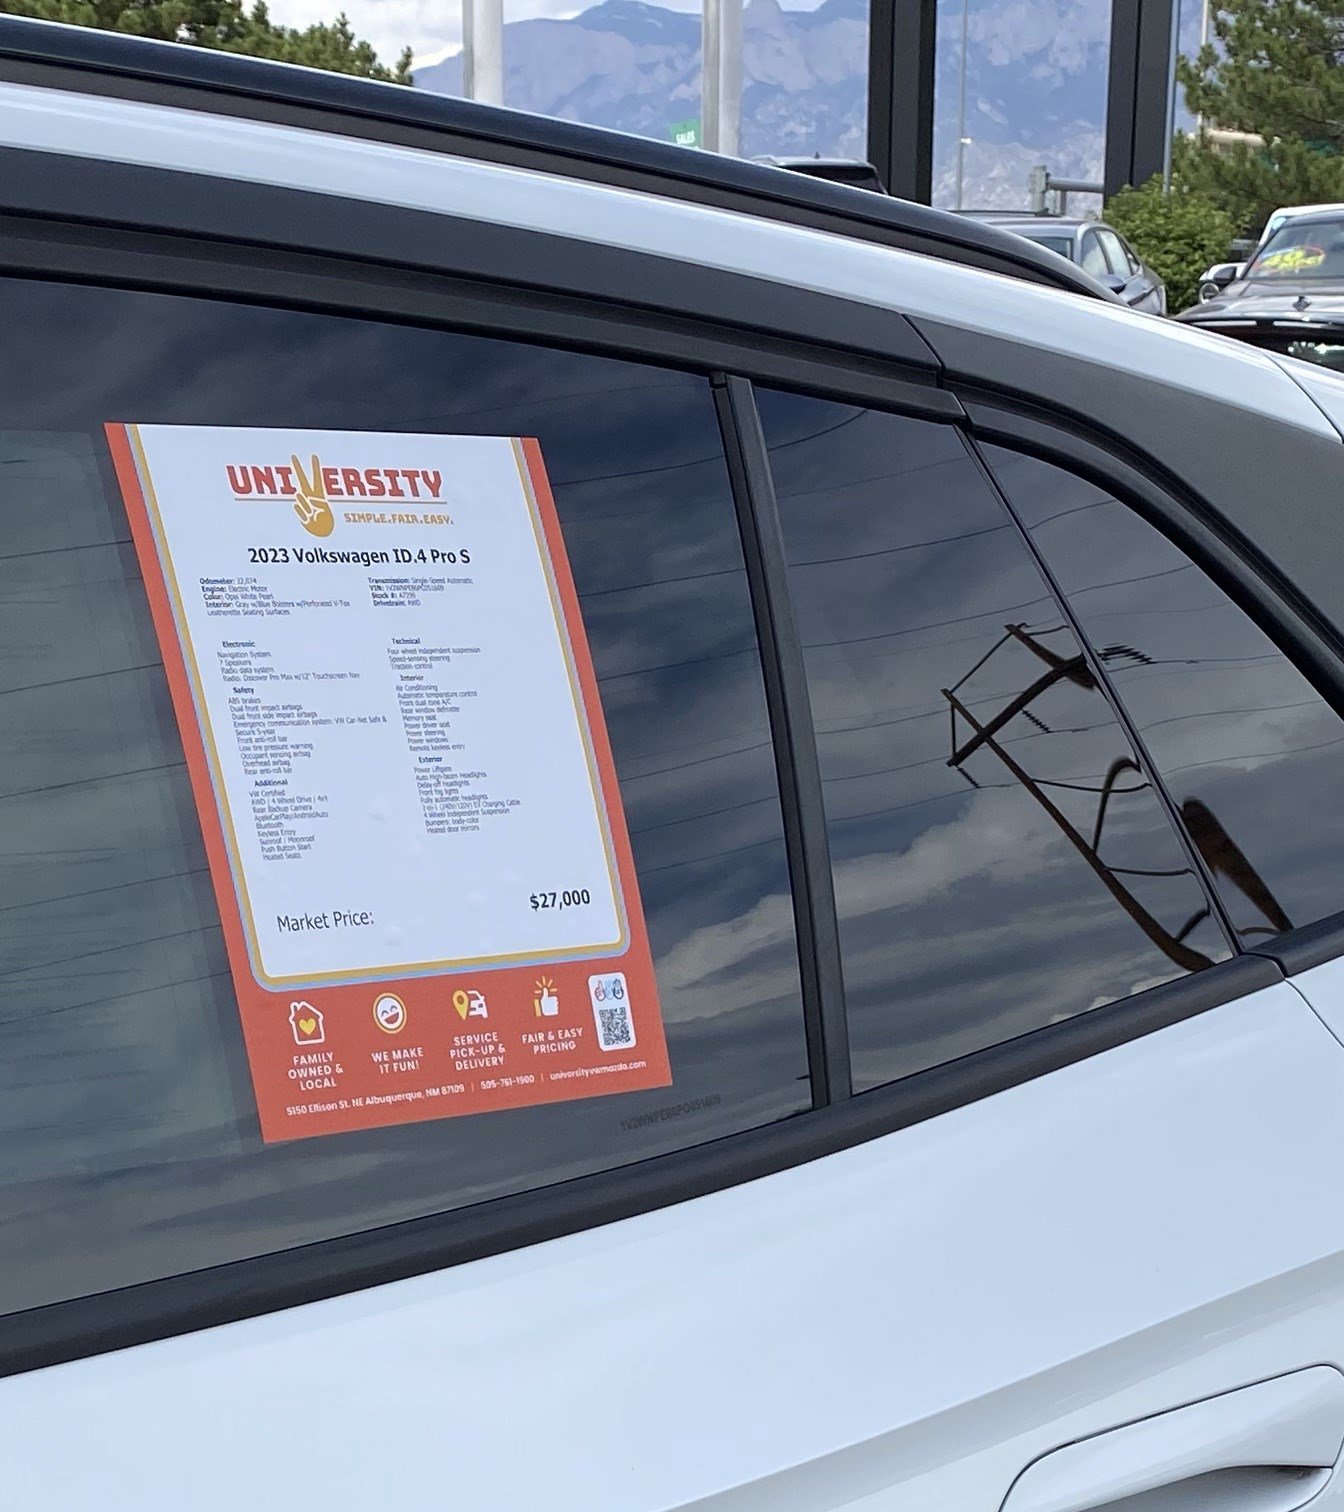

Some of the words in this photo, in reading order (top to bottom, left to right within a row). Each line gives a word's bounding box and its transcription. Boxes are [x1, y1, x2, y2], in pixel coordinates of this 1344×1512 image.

[246, 547, 290, 563] 2023
[292, 547, 390, 566] Volkswagen
[392, 547, 427, 563] ID.4
[429, 548, 457, 563] Pro
[458, 548, 471, 563] S
[200, 585, 227, 593] Engine:
[204, 600, 234, 608] Interior:
[221, 640, 256, 648] Electronic
[231, 686, 255, 695] Safety
[417, 755, 443, 763] Exterior
[253, 778, 288, 787] Additional
[275, 911, 330, 932] Market
[331, 907, 375, 927] Price:
[527, 888, 592, 911] $27,000
[452, 1031, 499, 1047] SERVICE
[520, 1031, 545, 1044] FAIR
[546, 1030, 555, 1041] &
[556, 1026, 585, 1039] EASY
[370, 1050, 389, 1063] WE
[390, 1046, 424, 1060] MAKE
[448, 1043, 495, 1059] PICK-UP
[496, 1042, 506, 1053] &
[531, 1039, 577, 1055] PRICING
[291, 1051, 335, 1066] FAMILY
[453, 1054, 505, 1071] DELIVERY
[286, 1064, 332, 1080] OWNED
[334, 1062, 344, 1074] &
[378, 1063, 390, 1075] IT
[392, 1059, 420, 1073] FUN!
[298, 1076, 337, 1091] LOCAL
[285, 1104, 307, 1116] 5150
[307, 1100, 338, 1113] Ellison
[350, 1096, 364, 1107] NE
[424, 1086, 440, 1097] NM
[440, 1083, 465, 1095] 87109
